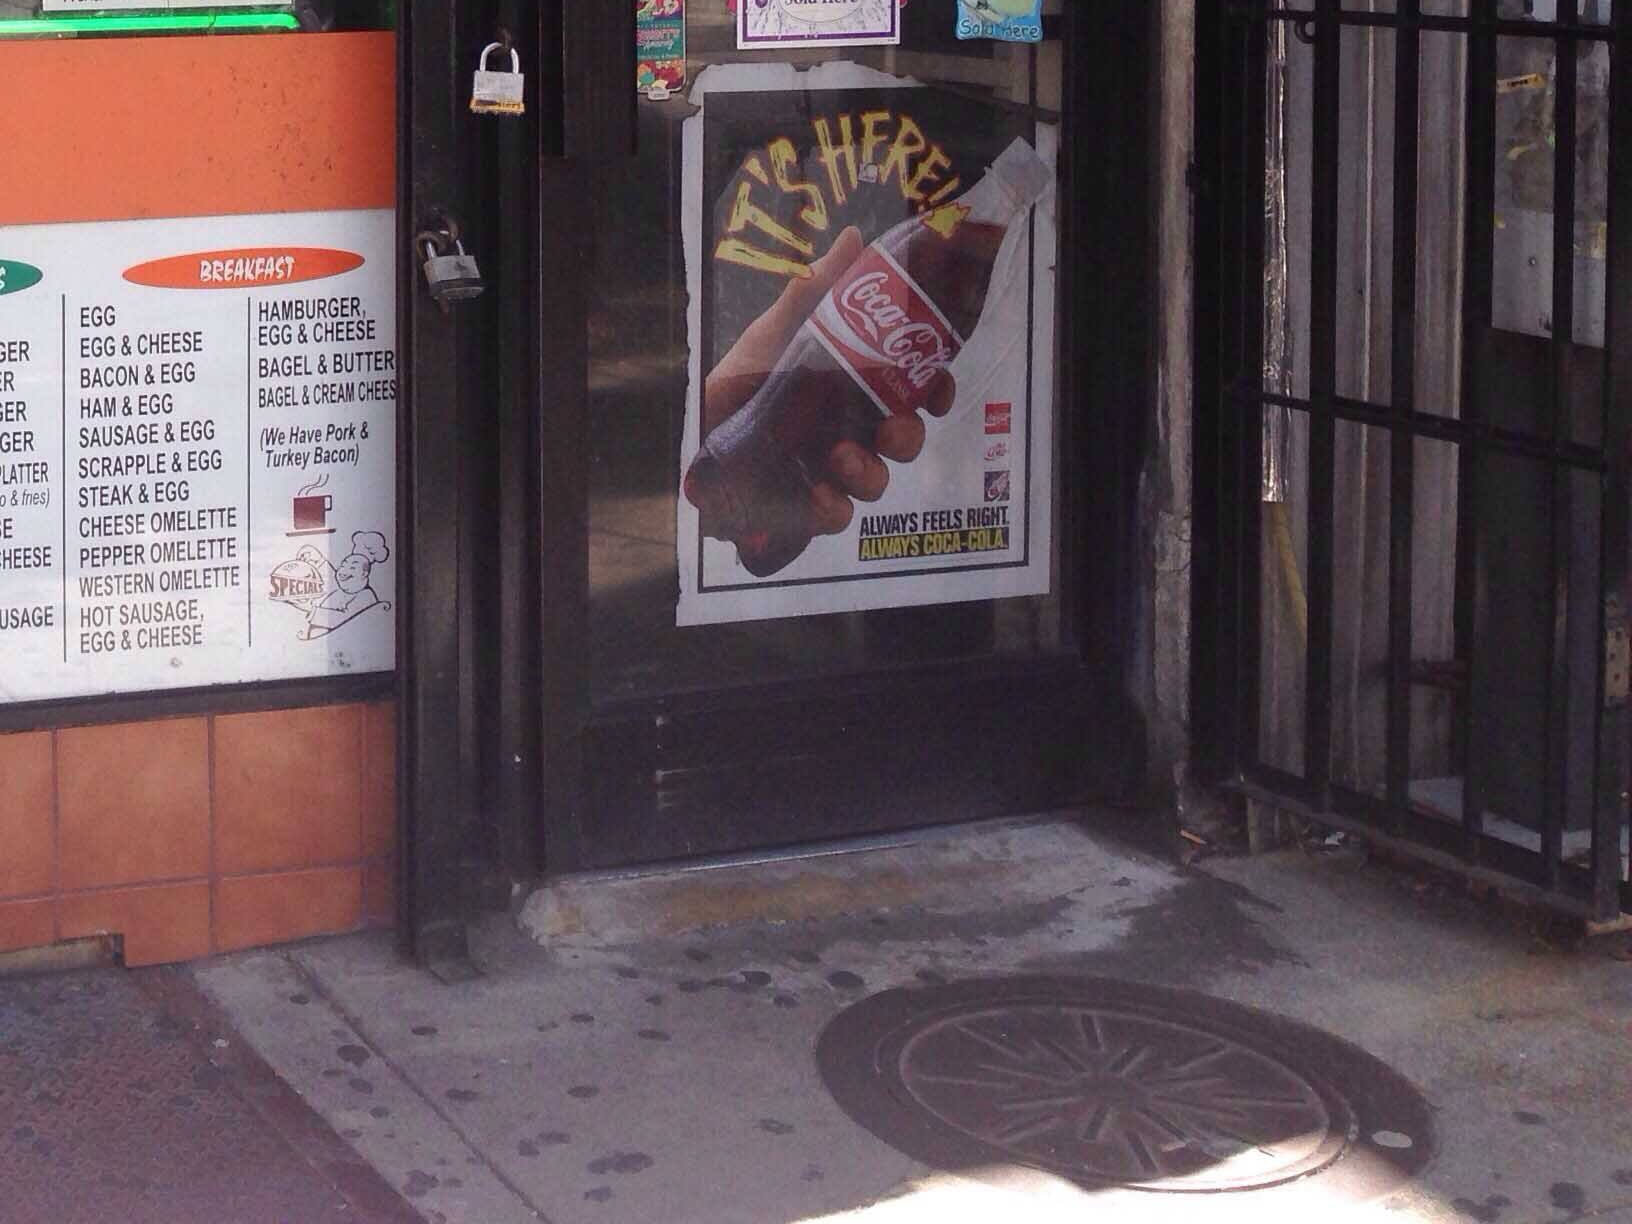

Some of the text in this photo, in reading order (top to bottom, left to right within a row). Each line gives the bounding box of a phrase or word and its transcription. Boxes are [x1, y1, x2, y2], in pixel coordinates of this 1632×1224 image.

[715, 136, 828, 277] IT'S
[200, 256, 294, 282] BREAKFAST
[81, 306, 115, 327] EGG
[841, 271, 952, 388] Coca-Cola
[81, 362, 195, 388] BACON & EGG
[260, 421, 368, 451] (We Have Pork &
[266, 443, 359, 470] Turkey Bacon)
[11, 490, 18, 506] &
[22, 488, 49, 508] fries)
[860, 506, 1009, 536] ALWAYS FEELS RIGHT.
[861, 535, 918, 559] ALWAYS
[79, 566, 239, 597] WESTERN OMELETTE
[269, 575, 326, 596] SPECIALS
